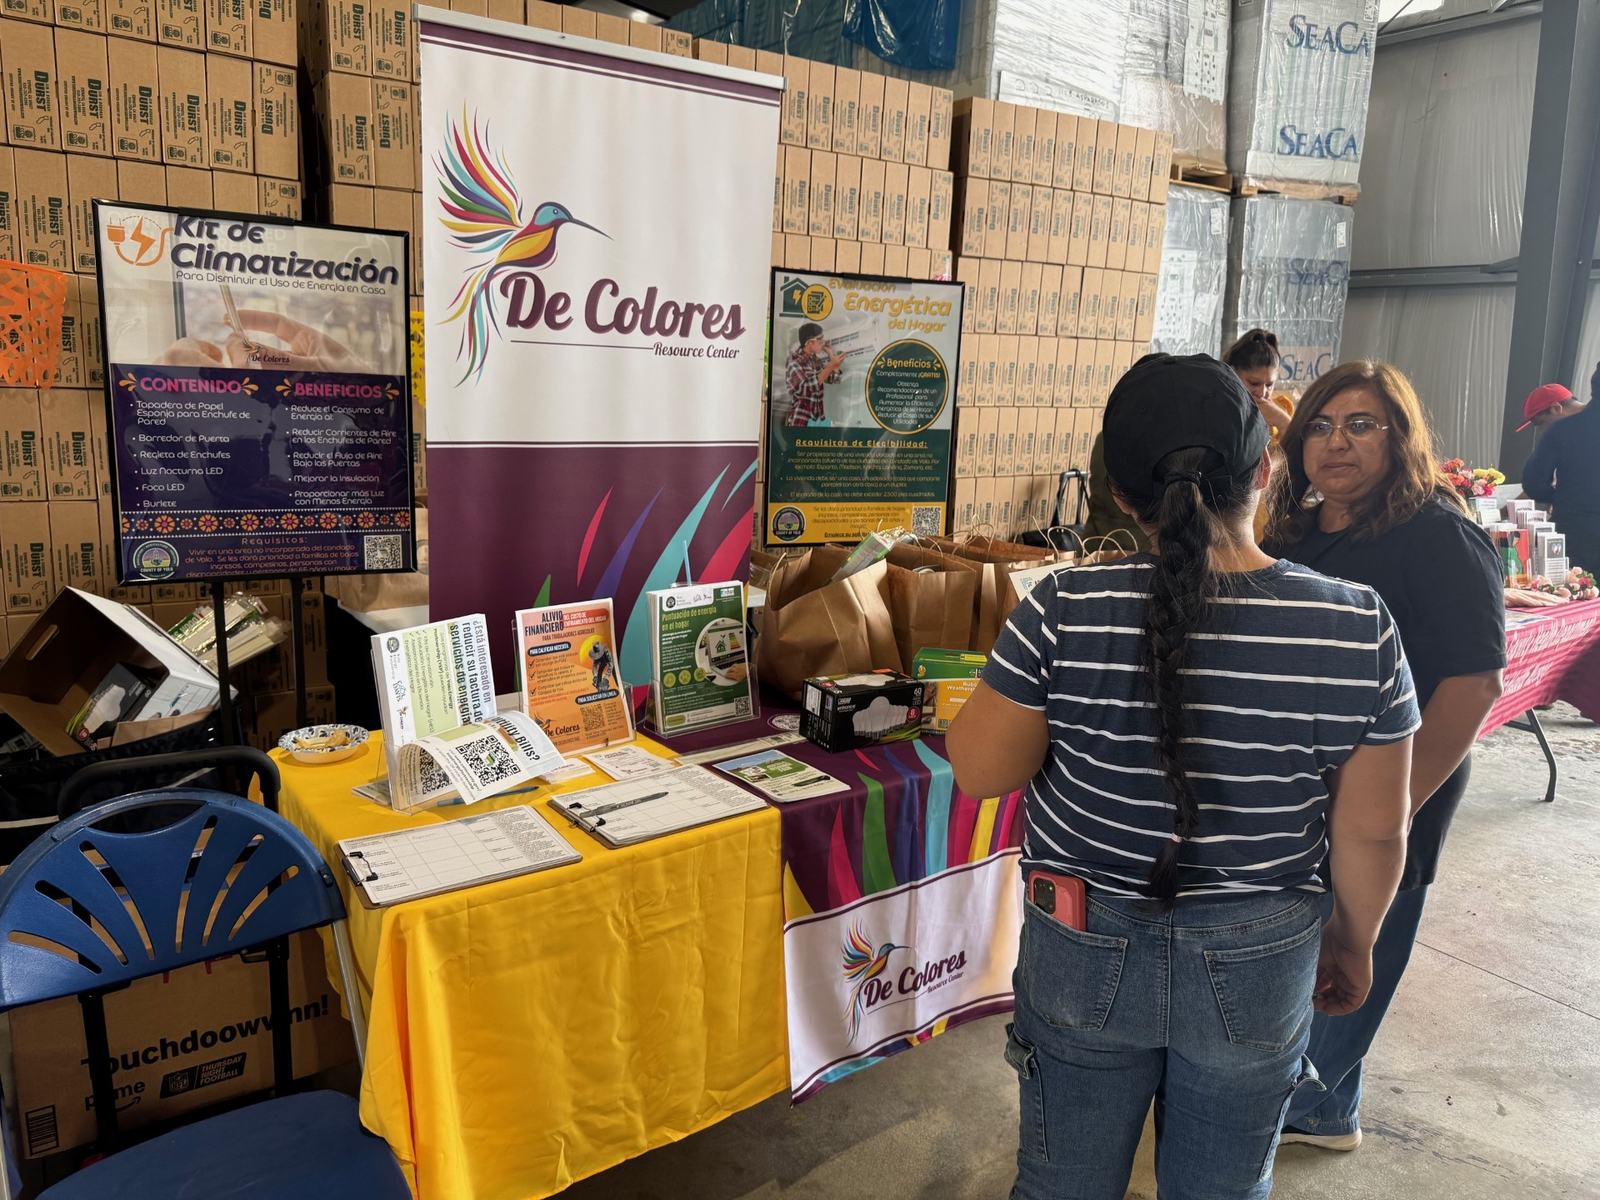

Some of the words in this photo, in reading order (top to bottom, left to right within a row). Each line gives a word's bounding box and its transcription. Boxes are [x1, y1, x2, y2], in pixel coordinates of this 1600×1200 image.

[352, 4, 364, 41] DURST
[394, 10, 406, 47] DURST
[34, 70, 49, 112] DURST
[88, 78, 101, 119] DURST
[139, 85, 152, 125] DURST
[187, 94, 200, 133] DURST
[233, 100, 247, 138] DURST
[261, 97, 274, 135] DURST
[355, 115, 367, 151] DURST
[380, 113, 391, 149] DURST
[1278, 124, 1359, 160] SEACA
[48, 196, 63, 236] DURST
[174, 215, 220, 240] Kit
[227, 221, 266, 244] de
[171, 243, 399, 285] Climatización
[176, 270, 204, 281] Para
[206, 272, 256, 285] Disminuir
[259, 276, 268, 286] el
[270, 278, 290, 288] Uso
[292, 280, 305, 289] de
[347, 284, 359, 293] en
[361, 285, 386, 295] Casa
[500, 271, 574, 331] De
[584, 278, 746, 341] Colores
[843, 292, 952, 318] Energética
[888, 318, 906, 330] del
[908, 319, 946, 333] Hogar
[653, 342, 704, 358] Resource
[706, 344, 740, 359] Center
[886, 358, 931, 368] Beneficios
[140, 377, 241, 394] CONTENIDO
[295, 383, 382, 398] BENEFICIOS
[136, 400, 183, 410] Tapadera
[184, 402, 197, 410] de
[198, 402, 224, 411] Papel
[201, 410, 237, 419] Enchufe
[238, 411, 251, 419] de
[290, 404, 322, 413] Reduce
[331, 405, 371, 414] Consumo
[21, 430, 36, 468] DURST
[71, 431, 85, 468] DURST
[138, 434, 183, 442] Barredor
[184, 434, 197, 442] de
[140, 467, 158, 475] Luz
[205, 467, 224, 475] LED
[177, 451, 189, 459] de
[190, 451, 231, 460] Enchufes
[142, 483, 165, 491] Foco
[166, 483, 185, 491] LED
[29, 542, 44, 578] DURST
[80, 542, 94, 577] DURST
[524, 621, 564, 637] FINANCIERO
[541, 610, 563, 624] ALIVIO
[449, 625, 464, 669] servicios
[462, 622, 475, 657] reducir
[456, 671, 466, 683] de
[467, 660, 475, 671] su
[477, 644, 491, 690] interesado
[469, 673, 481, 709] factura
[483, 692, 490, 703] en
[474, 710, 483, 722] de
[555, 724, 580, 736] Colores
[515, 733, 540, 762] Bills?
[864, 978, 893, 1008] De
[899, 950, 968, 995] Colores
